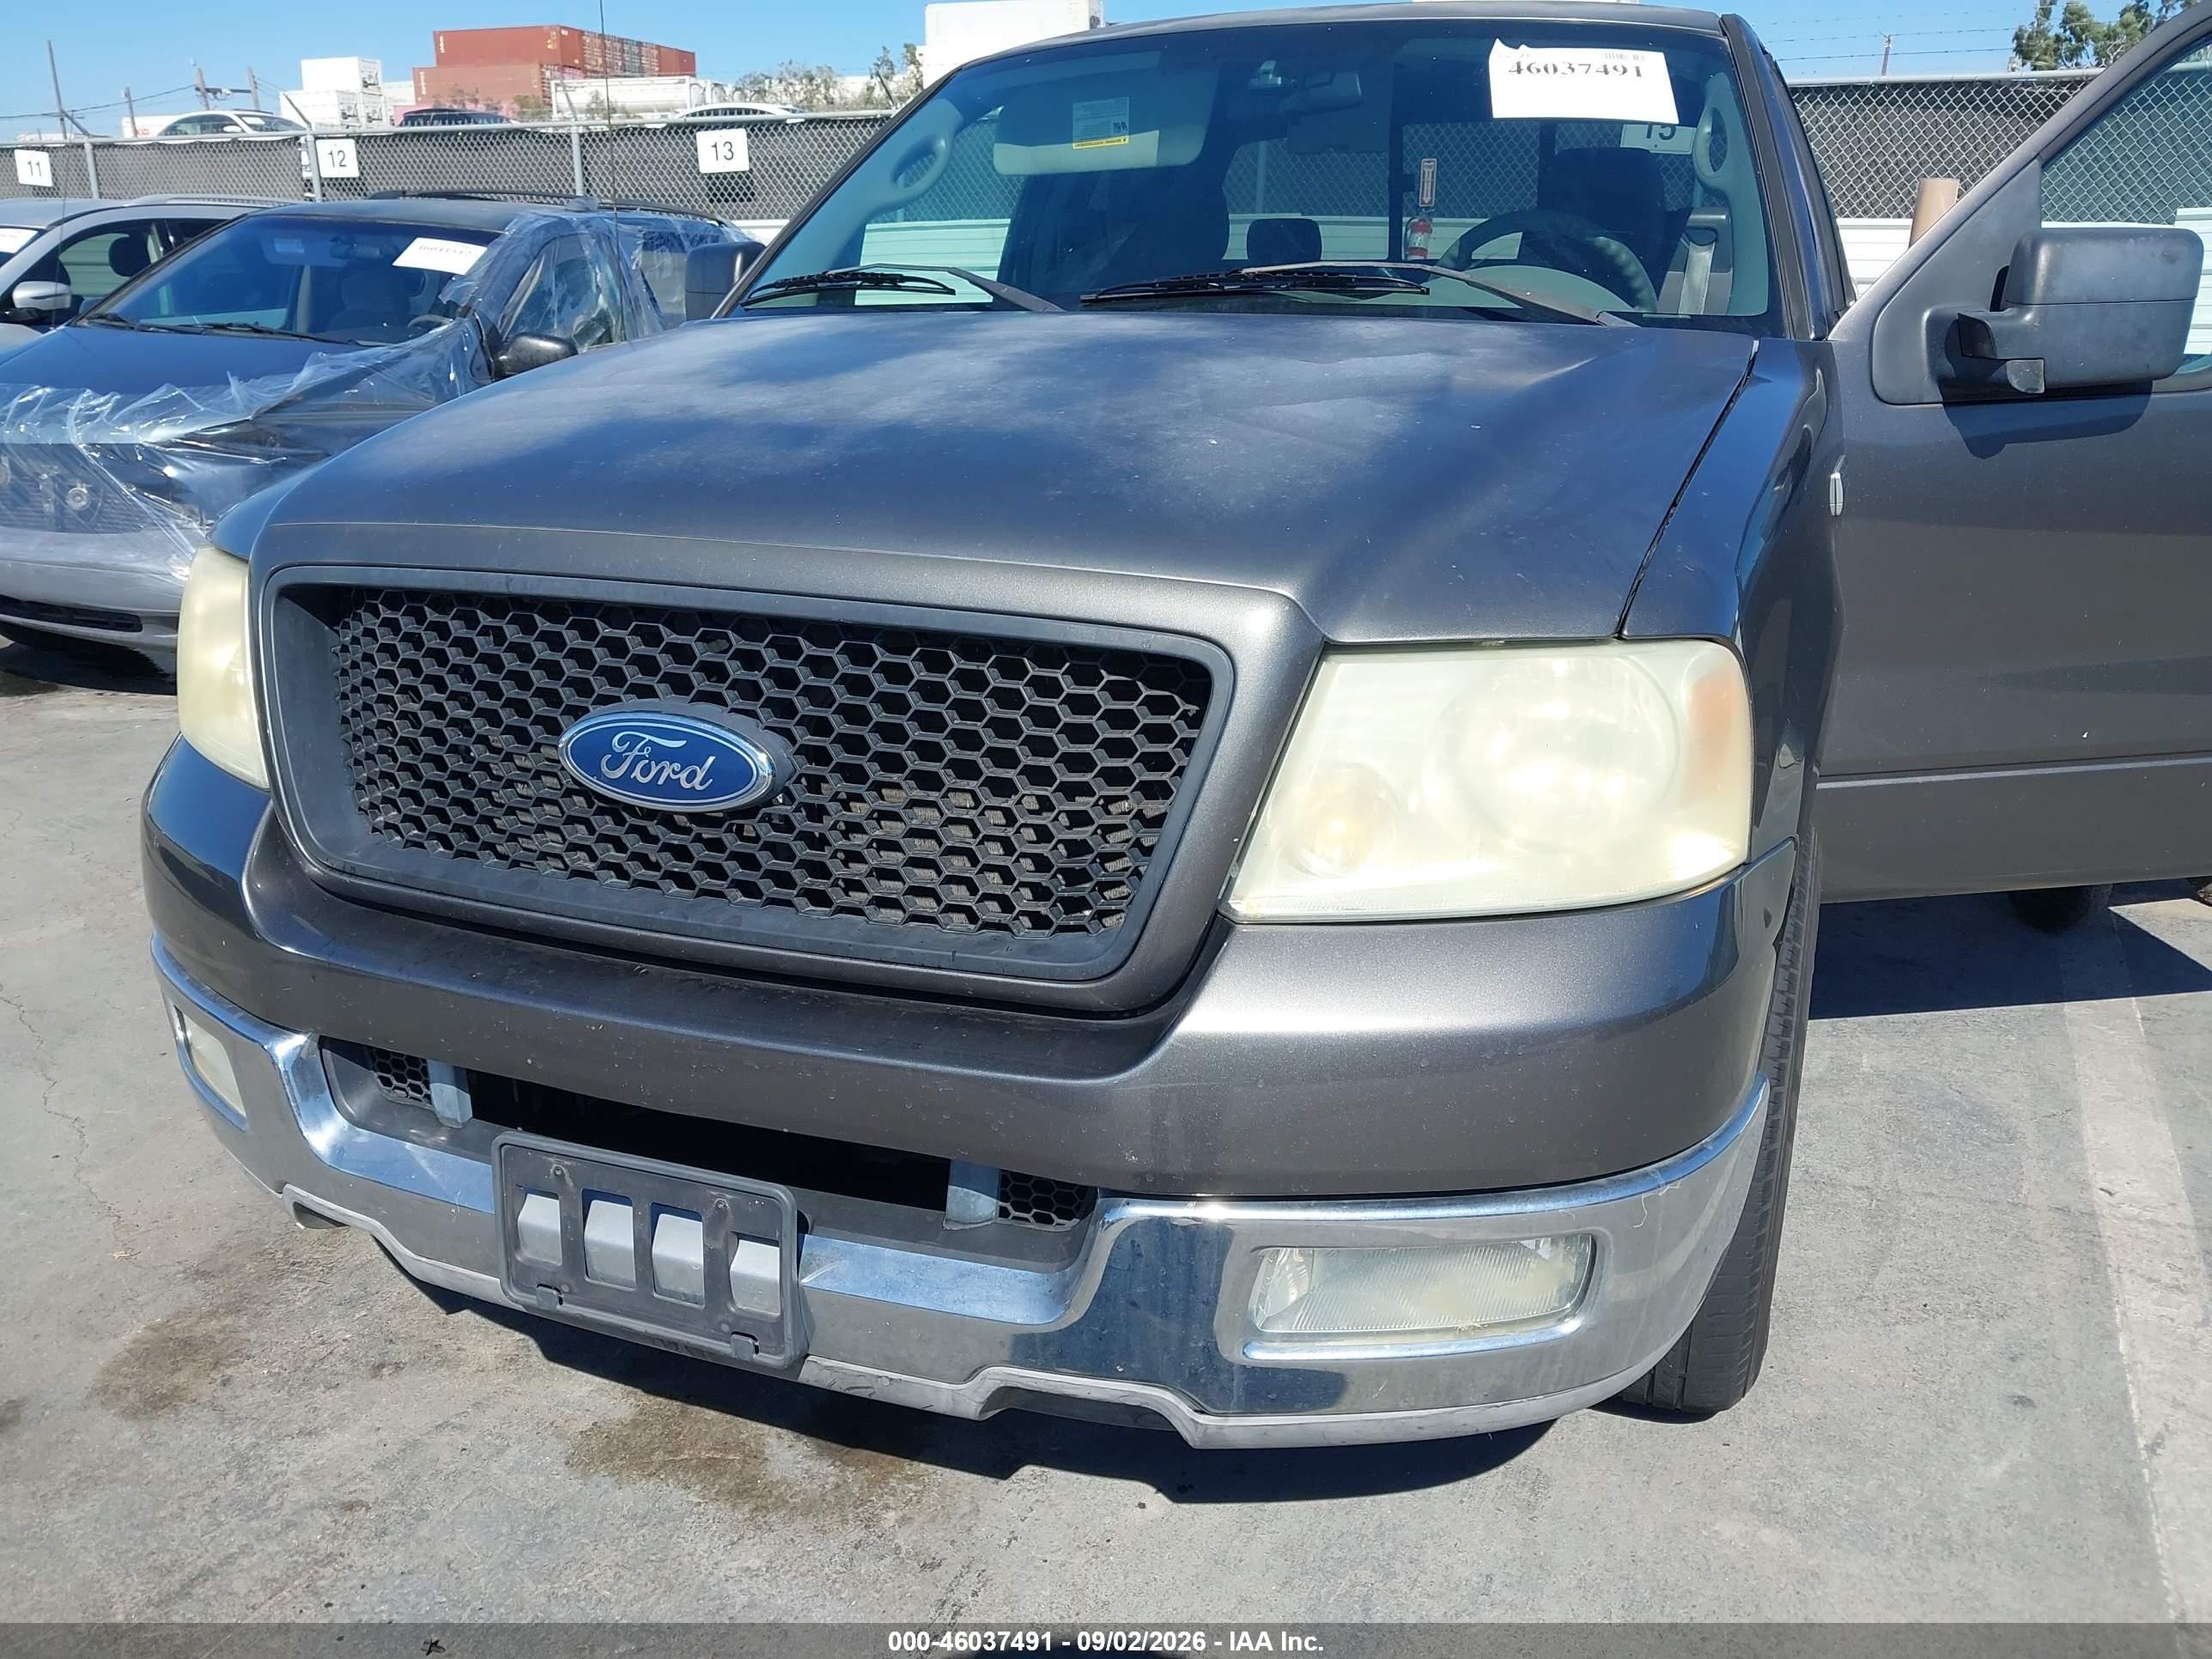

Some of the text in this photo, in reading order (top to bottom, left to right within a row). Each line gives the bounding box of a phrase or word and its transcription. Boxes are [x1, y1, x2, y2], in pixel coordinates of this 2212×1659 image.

[1508, 60, 1643, 78] 46037491
[327, 149, 347, 168] 12
[710, 141, 734, 161] 13
[27, 160, 42, 178] 11
[599, 731, 717, 791] Ford
